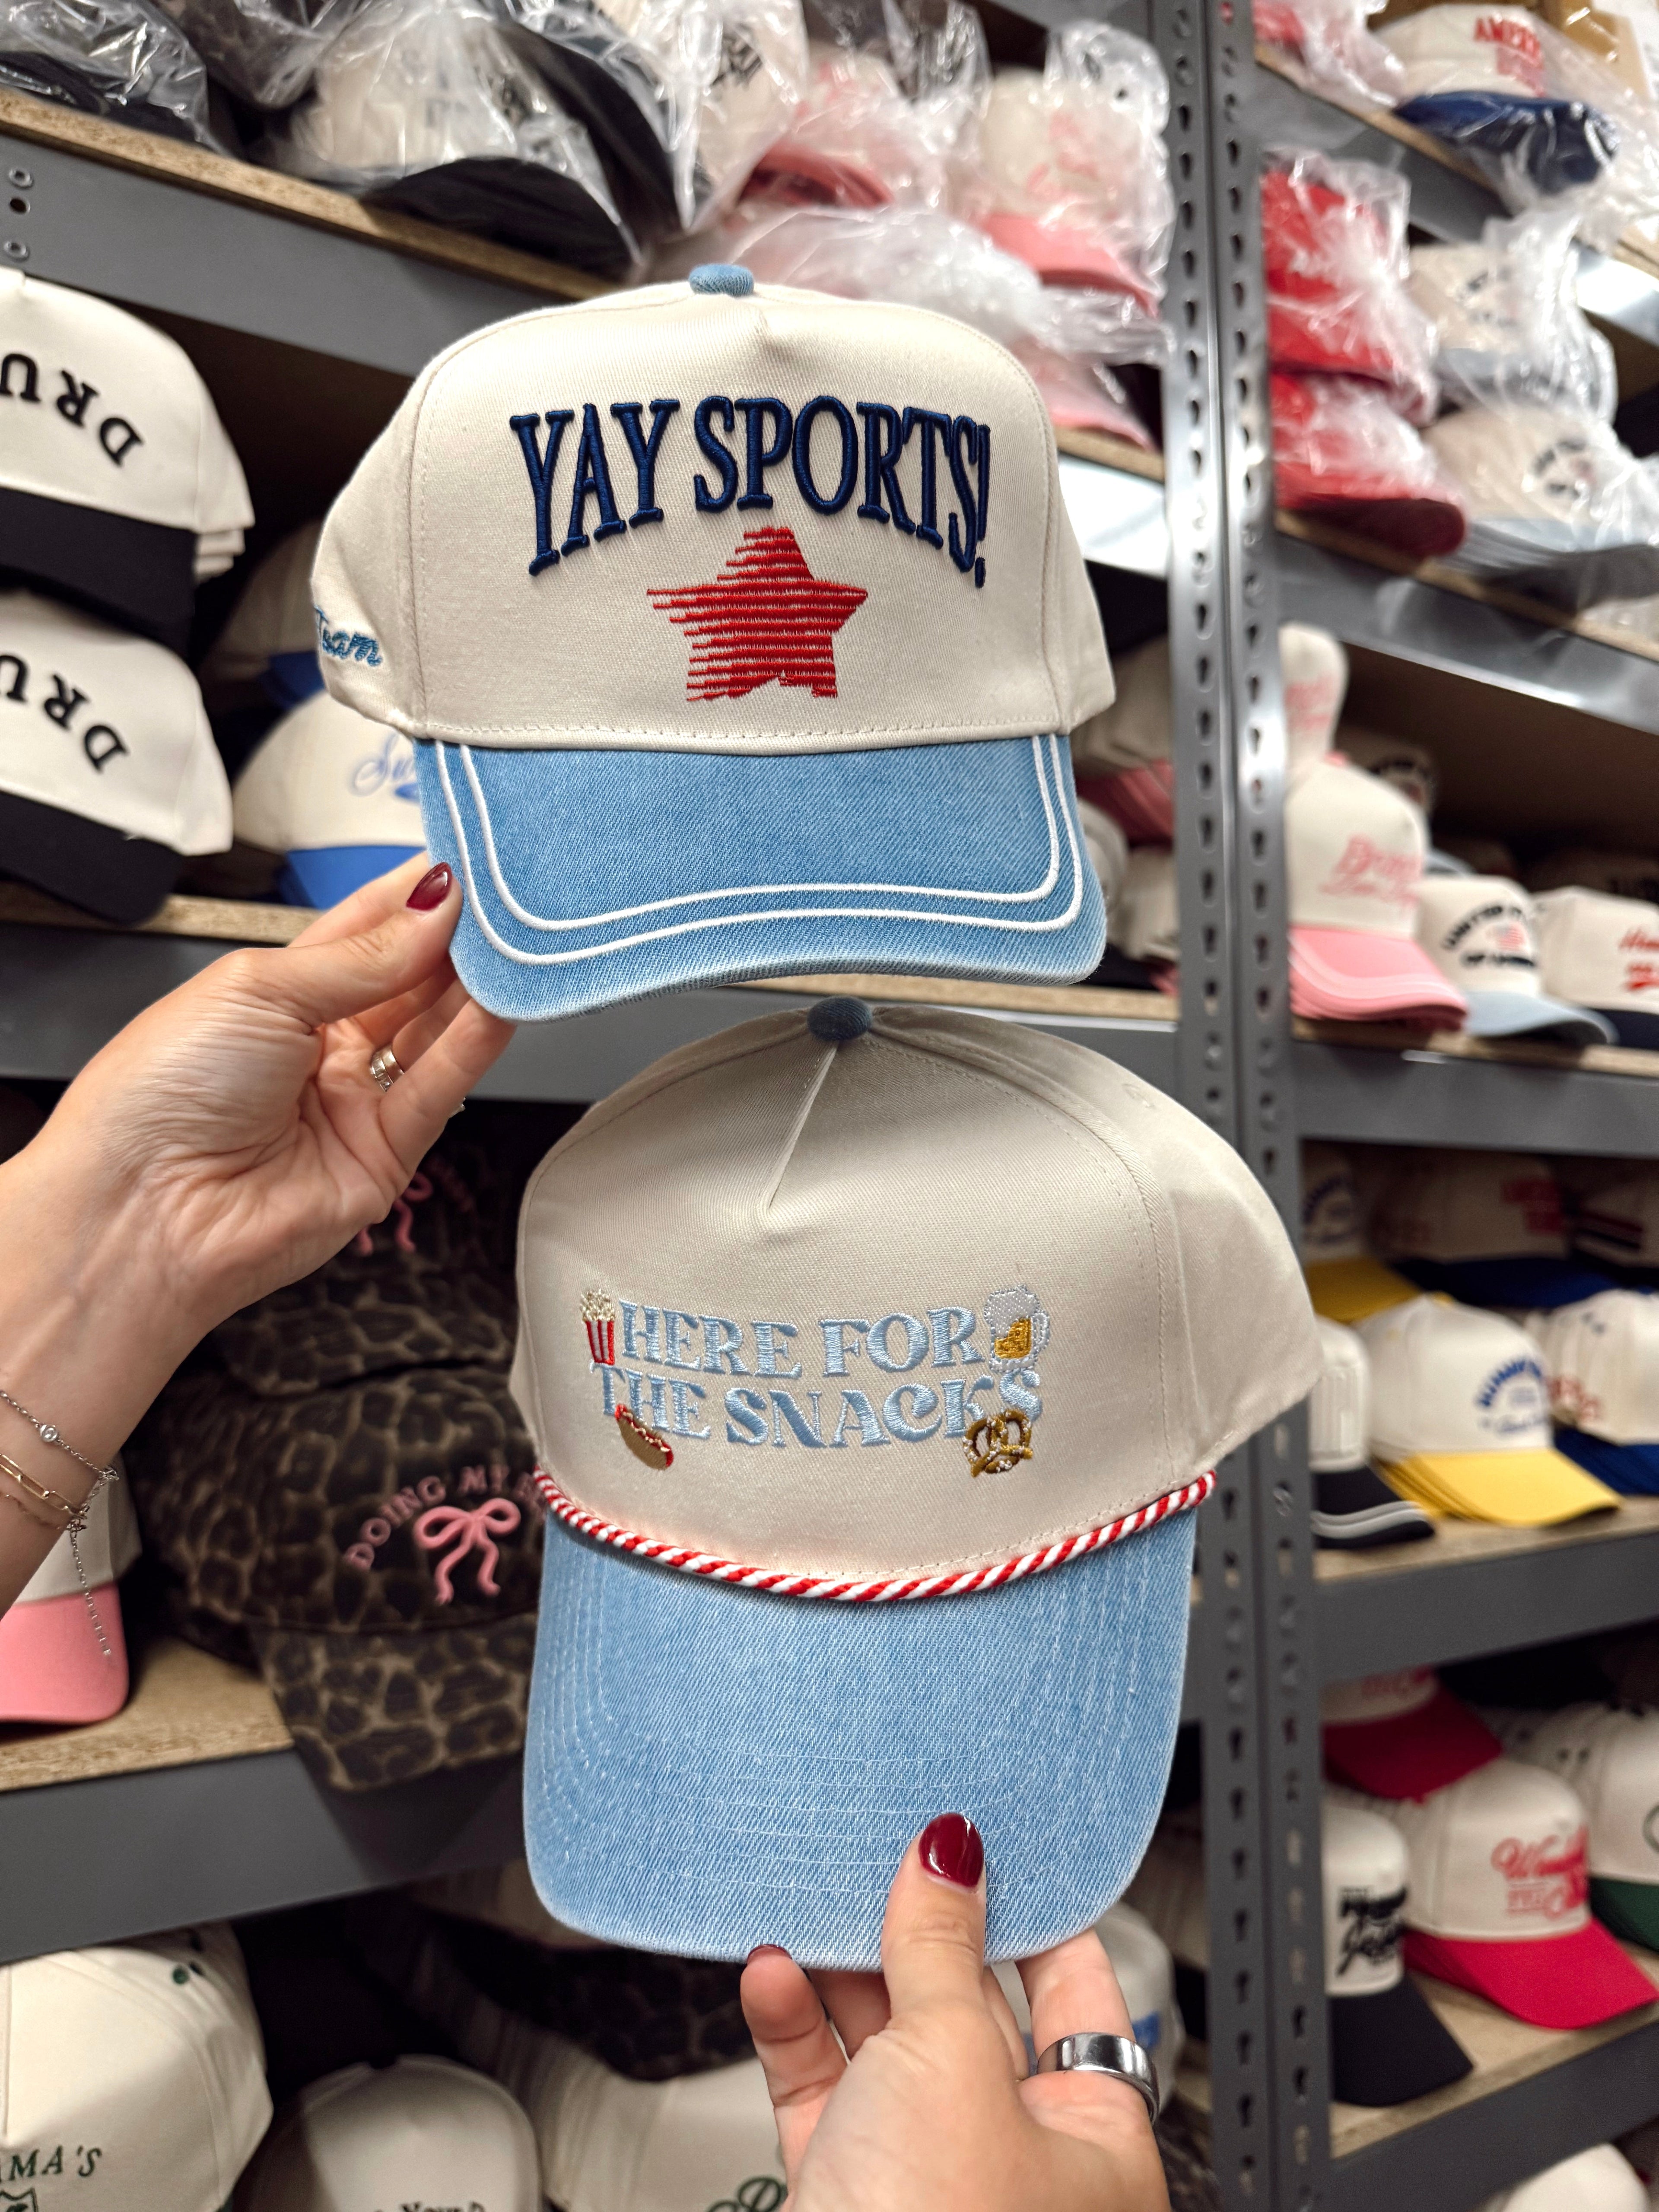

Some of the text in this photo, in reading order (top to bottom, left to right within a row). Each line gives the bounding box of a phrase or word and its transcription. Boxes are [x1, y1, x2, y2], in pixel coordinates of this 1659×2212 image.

[509, 395, 991, 589] YAY SPORTS!
[619, 1298, 986, 1379] HERE FOR
[589, 1358, 1043, 1449] THE SNACKS
[342, 1475, 447, 1573] DOING
[0, 2145, 102, 2183] MA'S
